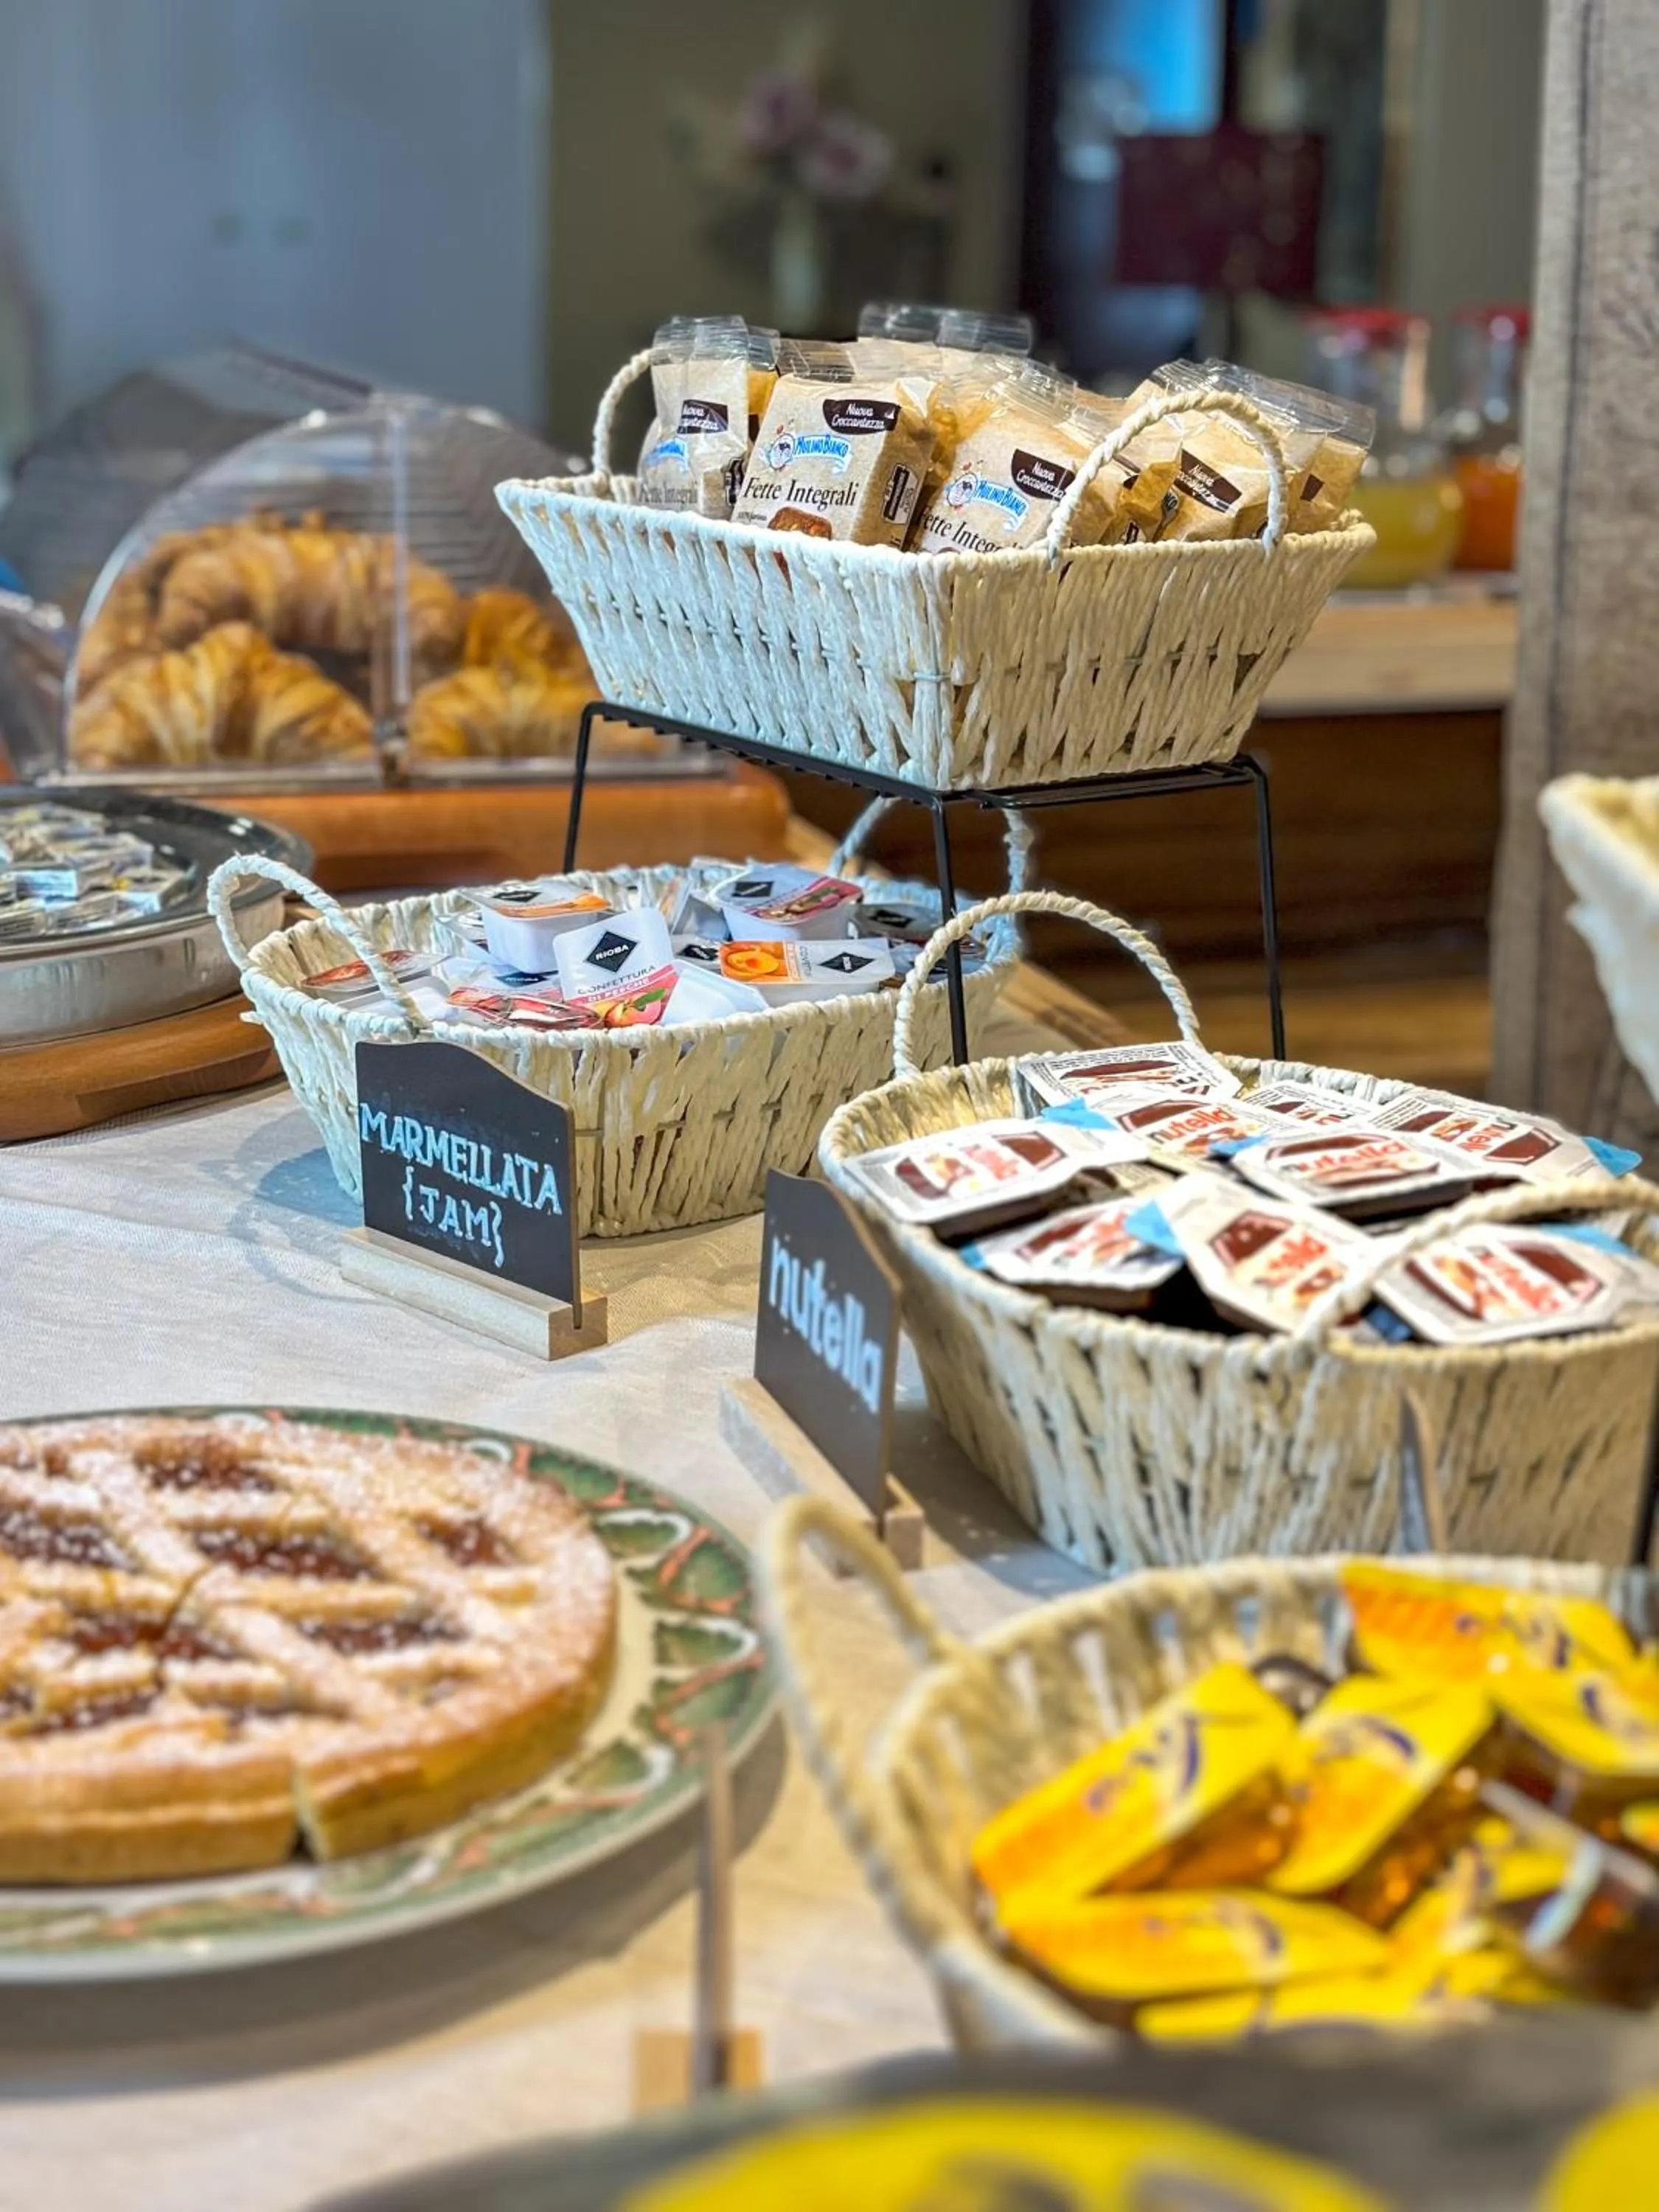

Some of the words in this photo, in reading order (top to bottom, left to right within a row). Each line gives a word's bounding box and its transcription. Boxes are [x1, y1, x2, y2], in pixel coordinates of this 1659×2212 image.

[831, 414, 886, 429] Croccantezza
[846, 403, 874, 417] Nuova
[1032, 461, 1057, 481] Nuova
[743, 477, 782, 500] Fette
[787, 479, 860, 512] Integrali
[923, 514, 948, 538] ette
[595, 944, 630, 961] RIOBA
[1145, 1105, 1239, 1145] nutella
[359, 1102, 563, 1216] MARMELLATA
[1279, 1140, 1410, 1173] nutella
[768, 1234, 883, 1416] nutella
